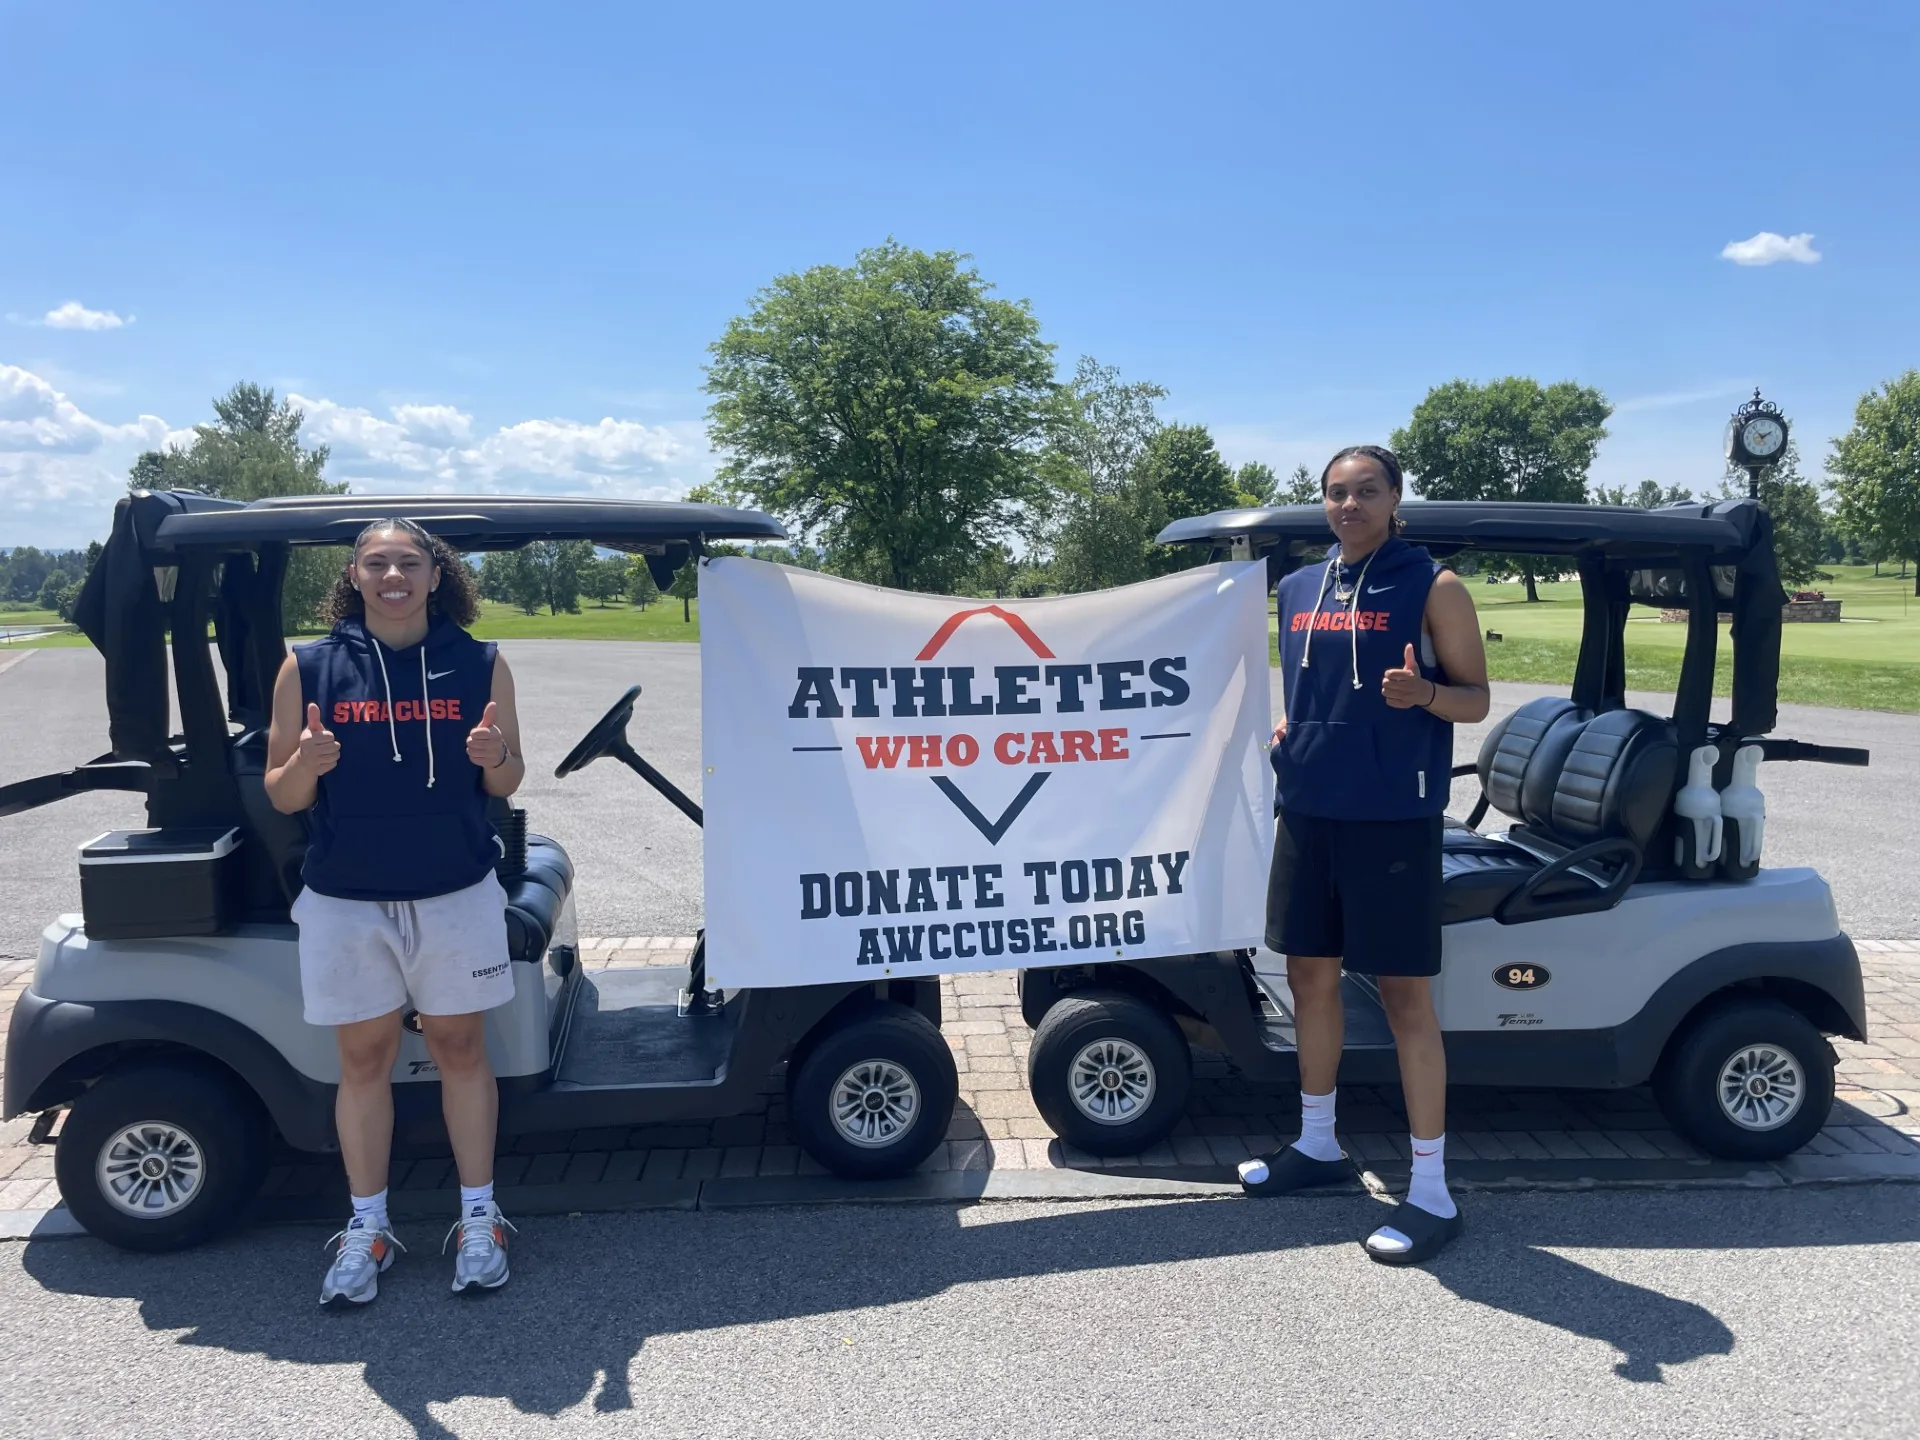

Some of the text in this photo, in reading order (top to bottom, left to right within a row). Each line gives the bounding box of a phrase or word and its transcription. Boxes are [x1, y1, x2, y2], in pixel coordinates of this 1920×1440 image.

[787, 656, 1191, 719] ATHLETES
[333, 699, 462, 723] SYRACUSE
[856, 728, 1129, 769] WHO CARE
[800, 850, 1190, 920] DONATE TODAY
[857, 910, 1146, 966] AWCCUSE.ORG
[1508, 968, 1535, 984] 94
[1497, 1013, 1544, 1027] Tempo
